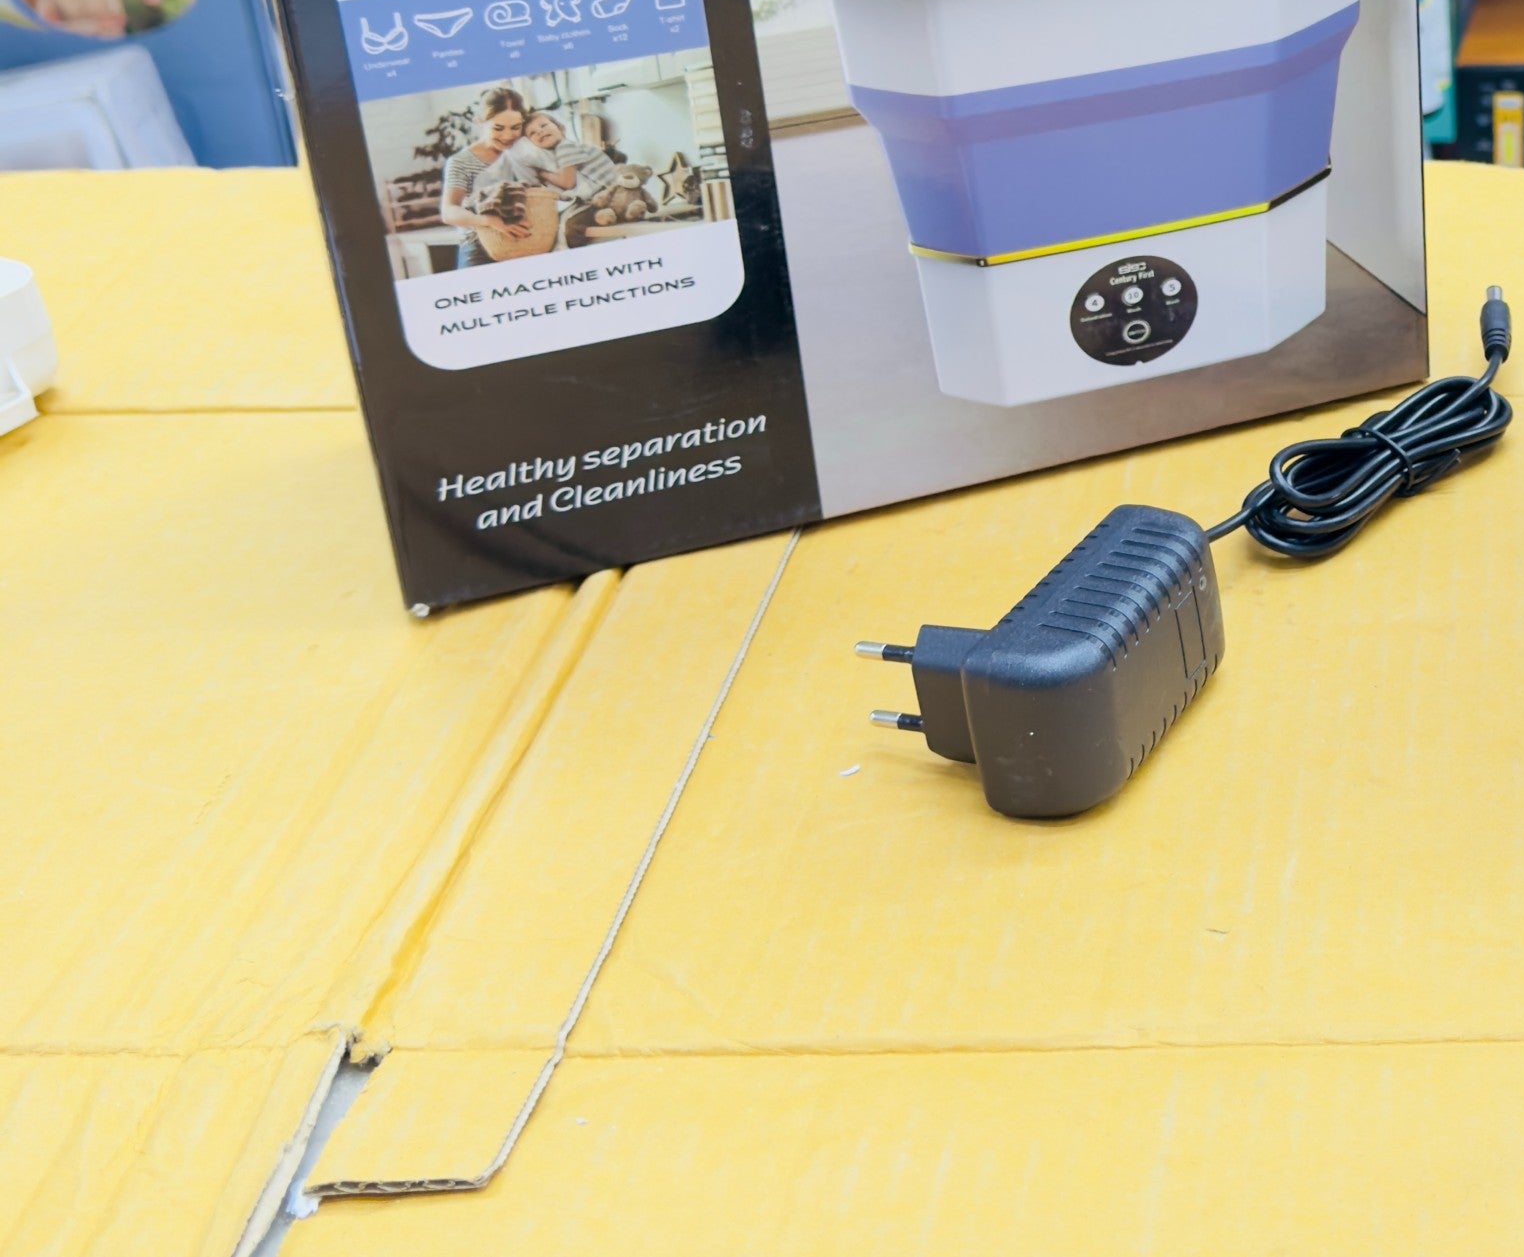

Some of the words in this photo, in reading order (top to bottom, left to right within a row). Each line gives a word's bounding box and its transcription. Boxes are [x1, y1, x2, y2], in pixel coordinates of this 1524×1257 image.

[659, 14, 685, 25] T-shirt
[608, 23, 629, 34] Sock
[500, 38, 526, 49] Towel
[537, 32, 560, 44] Baby
[612, 33, 629, 43] x12
[432, 49, 465, 60] Panties
[363, 57, 411, 72] Underwear
[434, 291, 483, 311] ONE
[491, 268, 599, 300] MACHINE
[605, 255, 664, 279] WITH
[1109, 274, 1138, 286] Century
[1138, 270, 1155, 280] First
[439, 300, 558, 335] MULTIPLE
[564, 276, 697, 310] FUNCTIONS
[437, 454, 577, 502] Healthy
[583, 413, 767, 468] separation
[476, 492, 543, 531] and
[549, 455, 742, 514] Cleanliness
